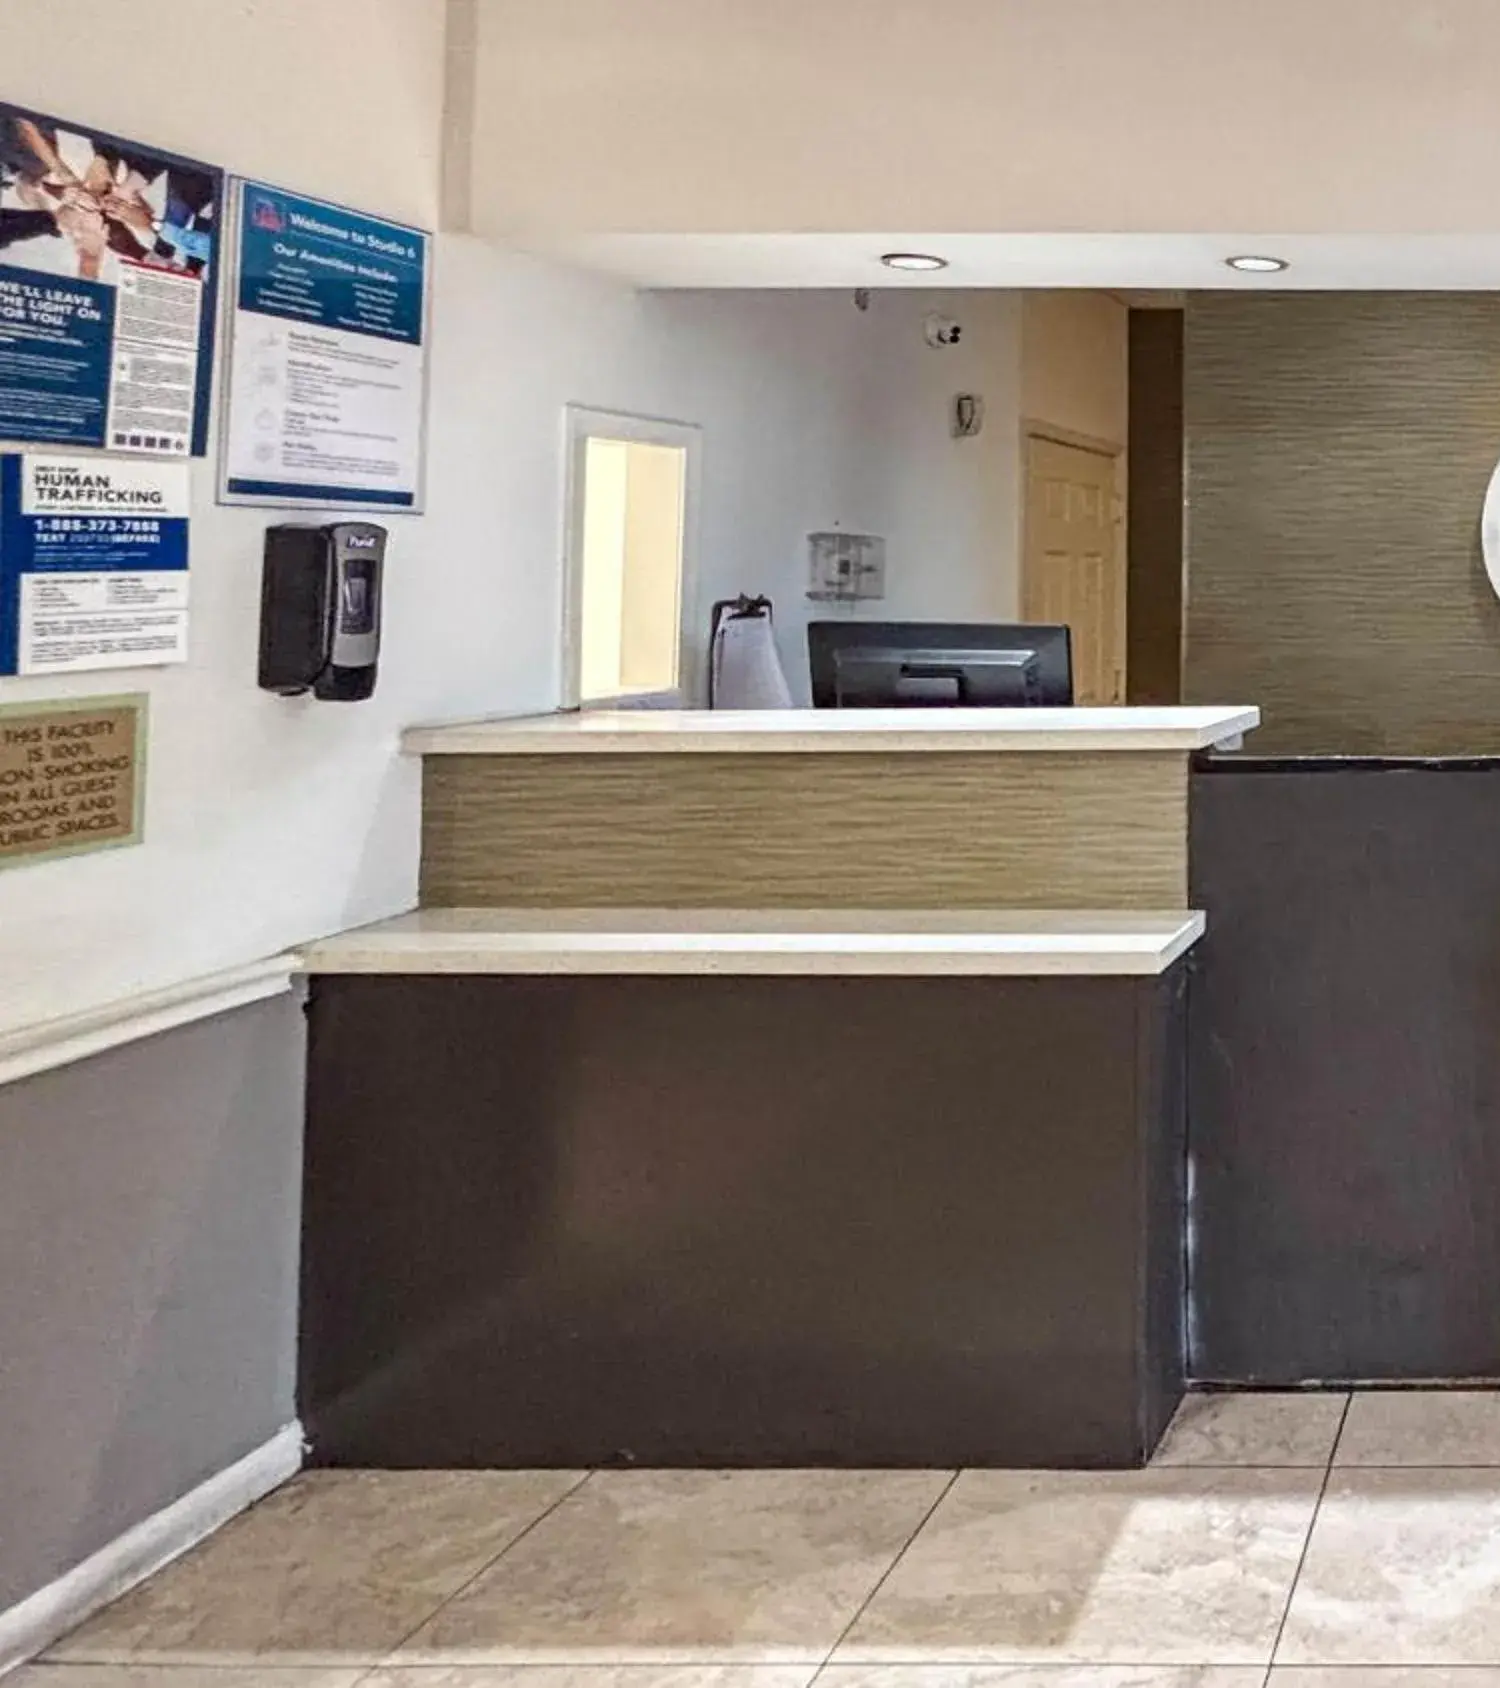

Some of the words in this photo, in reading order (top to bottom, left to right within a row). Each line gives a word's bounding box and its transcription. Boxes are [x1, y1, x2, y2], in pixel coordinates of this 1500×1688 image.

[289, 212, 349, 240] Welcome
[351, 230, 366, 244] to
[367, 234, 406, 256] Studio
[273, 241, 298, 258] Our
[45, 289, 92, 307] LEAVE
[28, 299, 73, 315] LIGHT
[77, 307, 101, 321] ON
[34, 473, 110, 489] HUMAN
[35, 487, 163, 504] TRAFFICKING
[4, 727, 42, 744] THIS
[47, 719, 115, 741] FACILITY
[27, 748, 45, 763] IS
[28, 782, 55, 801] ALL
[60, 774, 118, 797] GUEST
[77, 794, 116, 812] AND
[55, 812, 121, 838] SPACES
